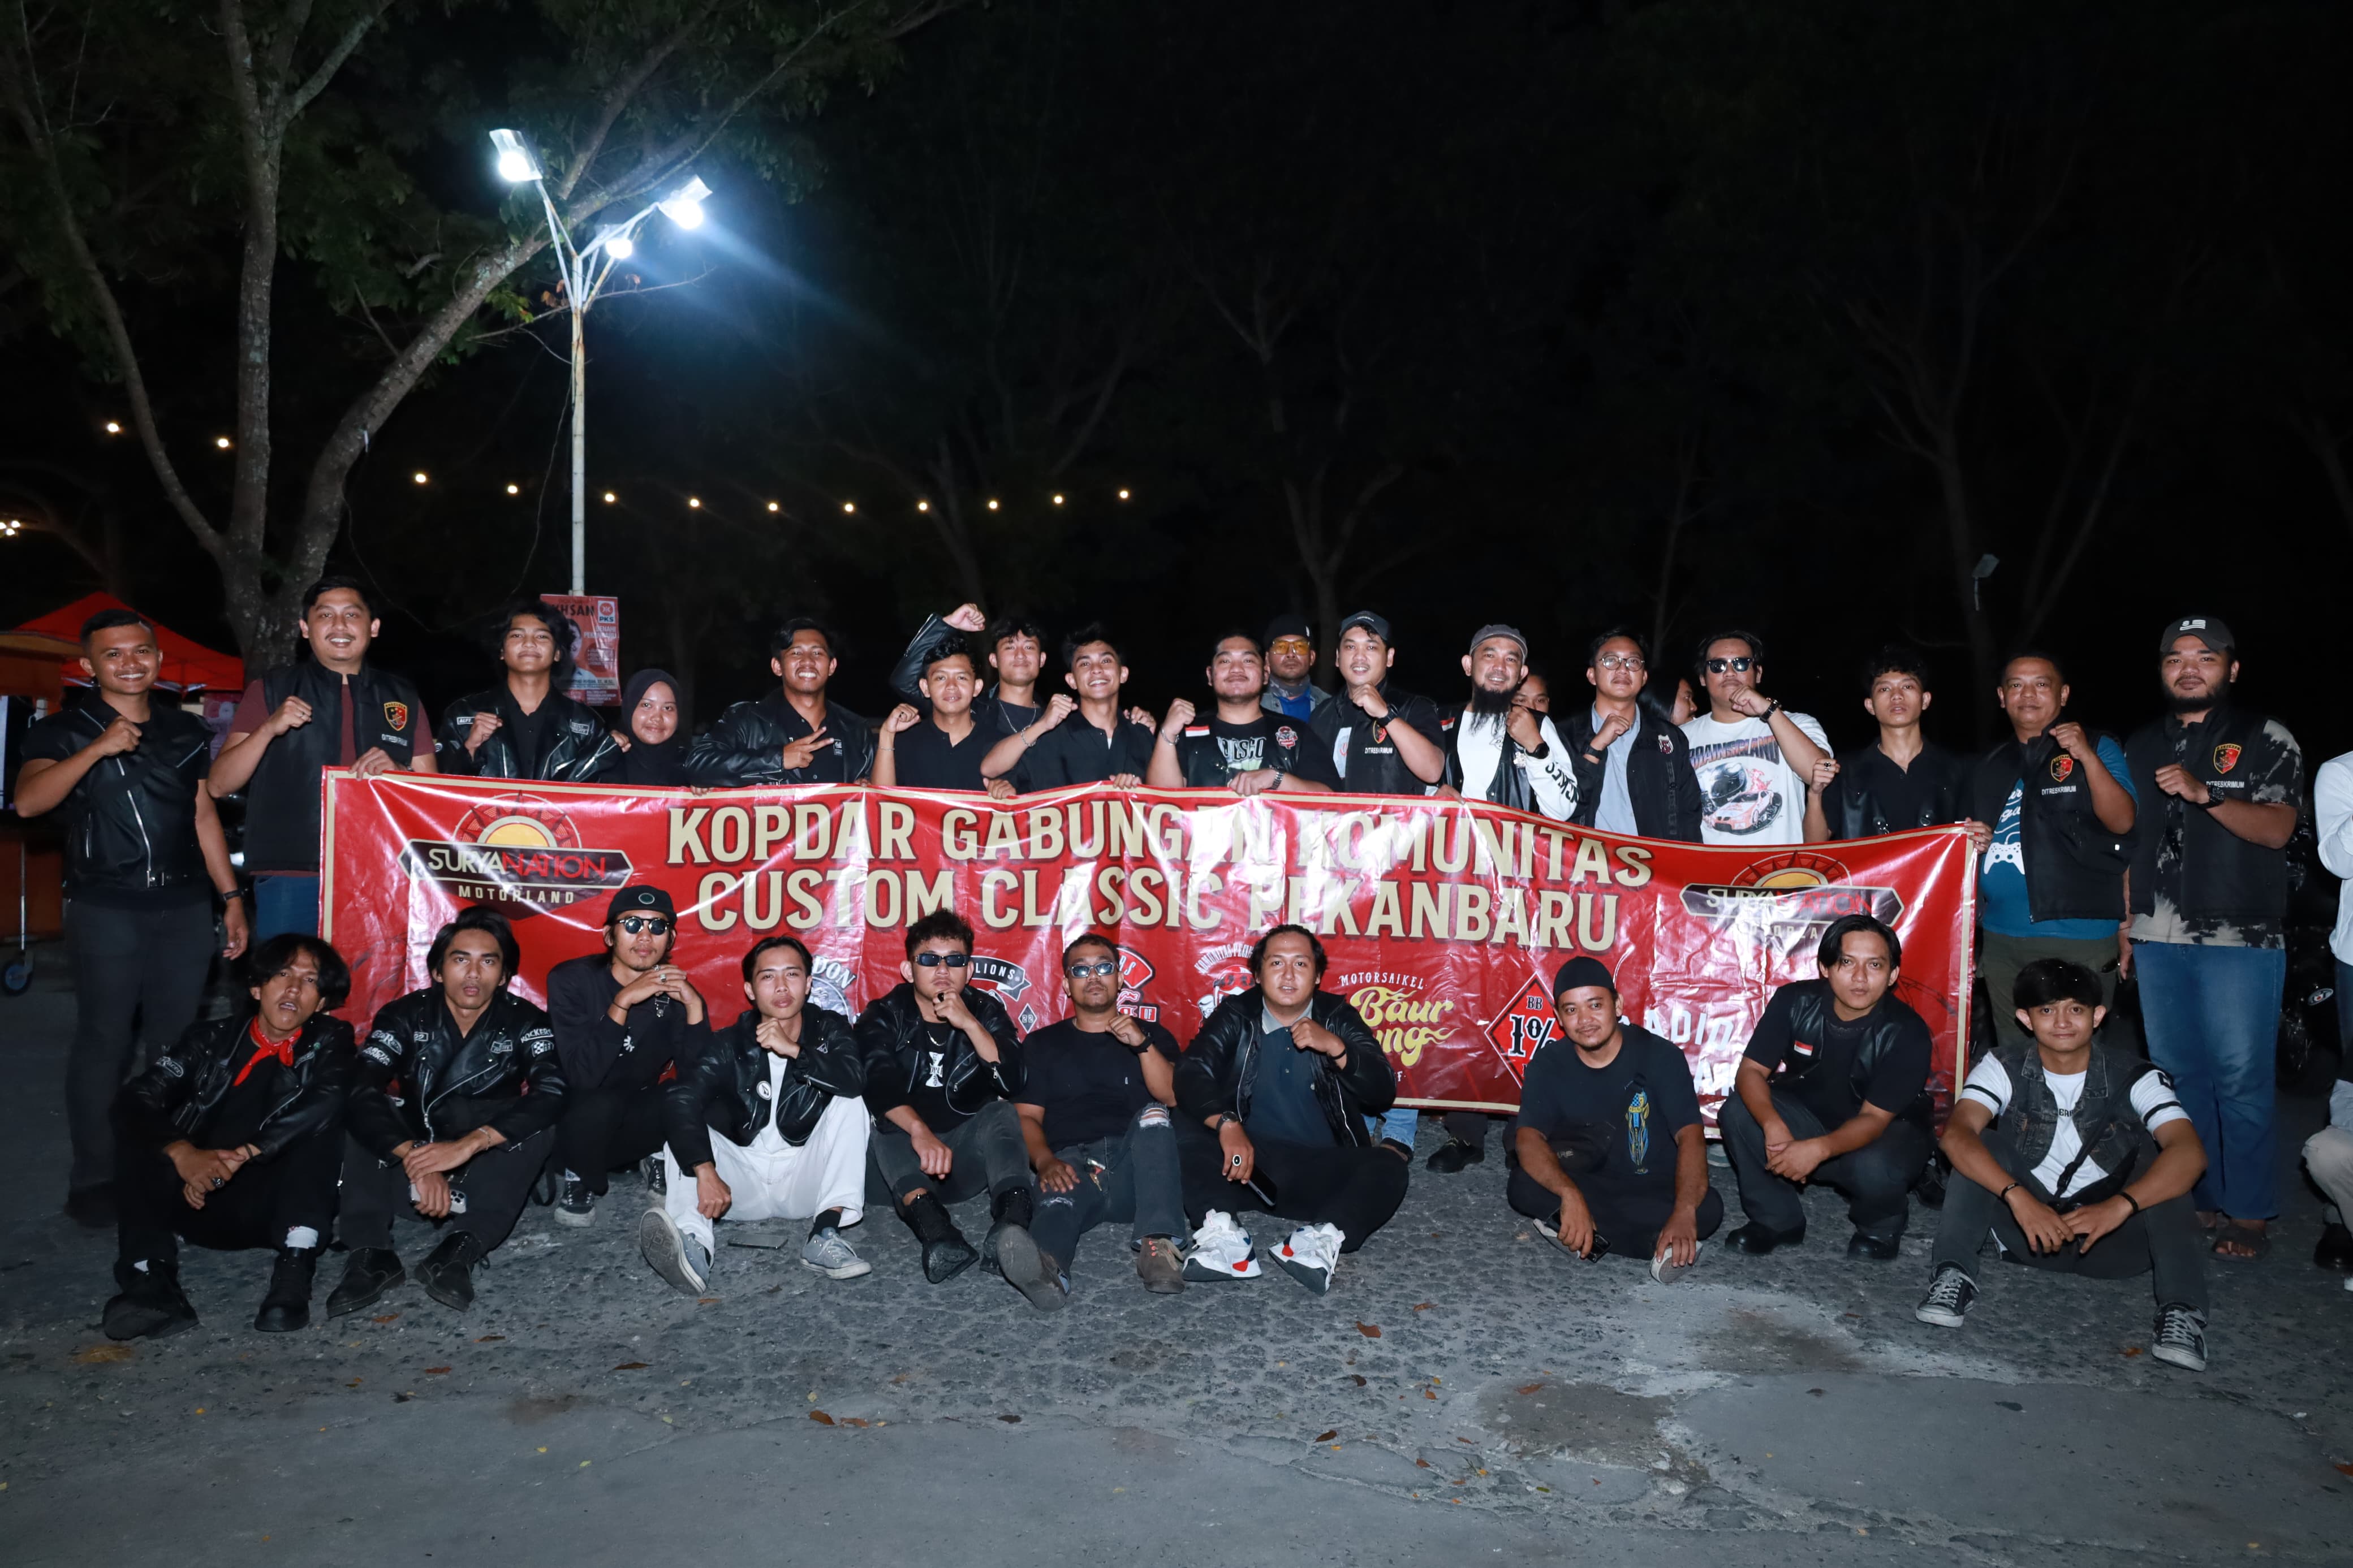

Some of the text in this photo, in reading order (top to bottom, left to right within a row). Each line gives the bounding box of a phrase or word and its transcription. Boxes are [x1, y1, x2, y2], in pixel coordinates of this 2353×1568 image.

[2041, 785, 2077, 795] DITRESKRIMUM
[667, 800, 1653, 887] KOPDAR GABUNGAN KOMUNITAS
[428, 848, 606, 879] SURYANATION
[458, 884, 575, 904] MOTORLAND
[698, 866, 1618, 952] CUSTOM CLASSIC PEKANBARU
[1194, 944, 1232, 974] KOMUNITAS
[1339, 971, 1424, 990] MOTORSAIKEL
[1350, 986, 1454, 1027] Baur
[1526, 995, 1543, 1011] BB
[1507, 1014, 1557, 1060] 1%
